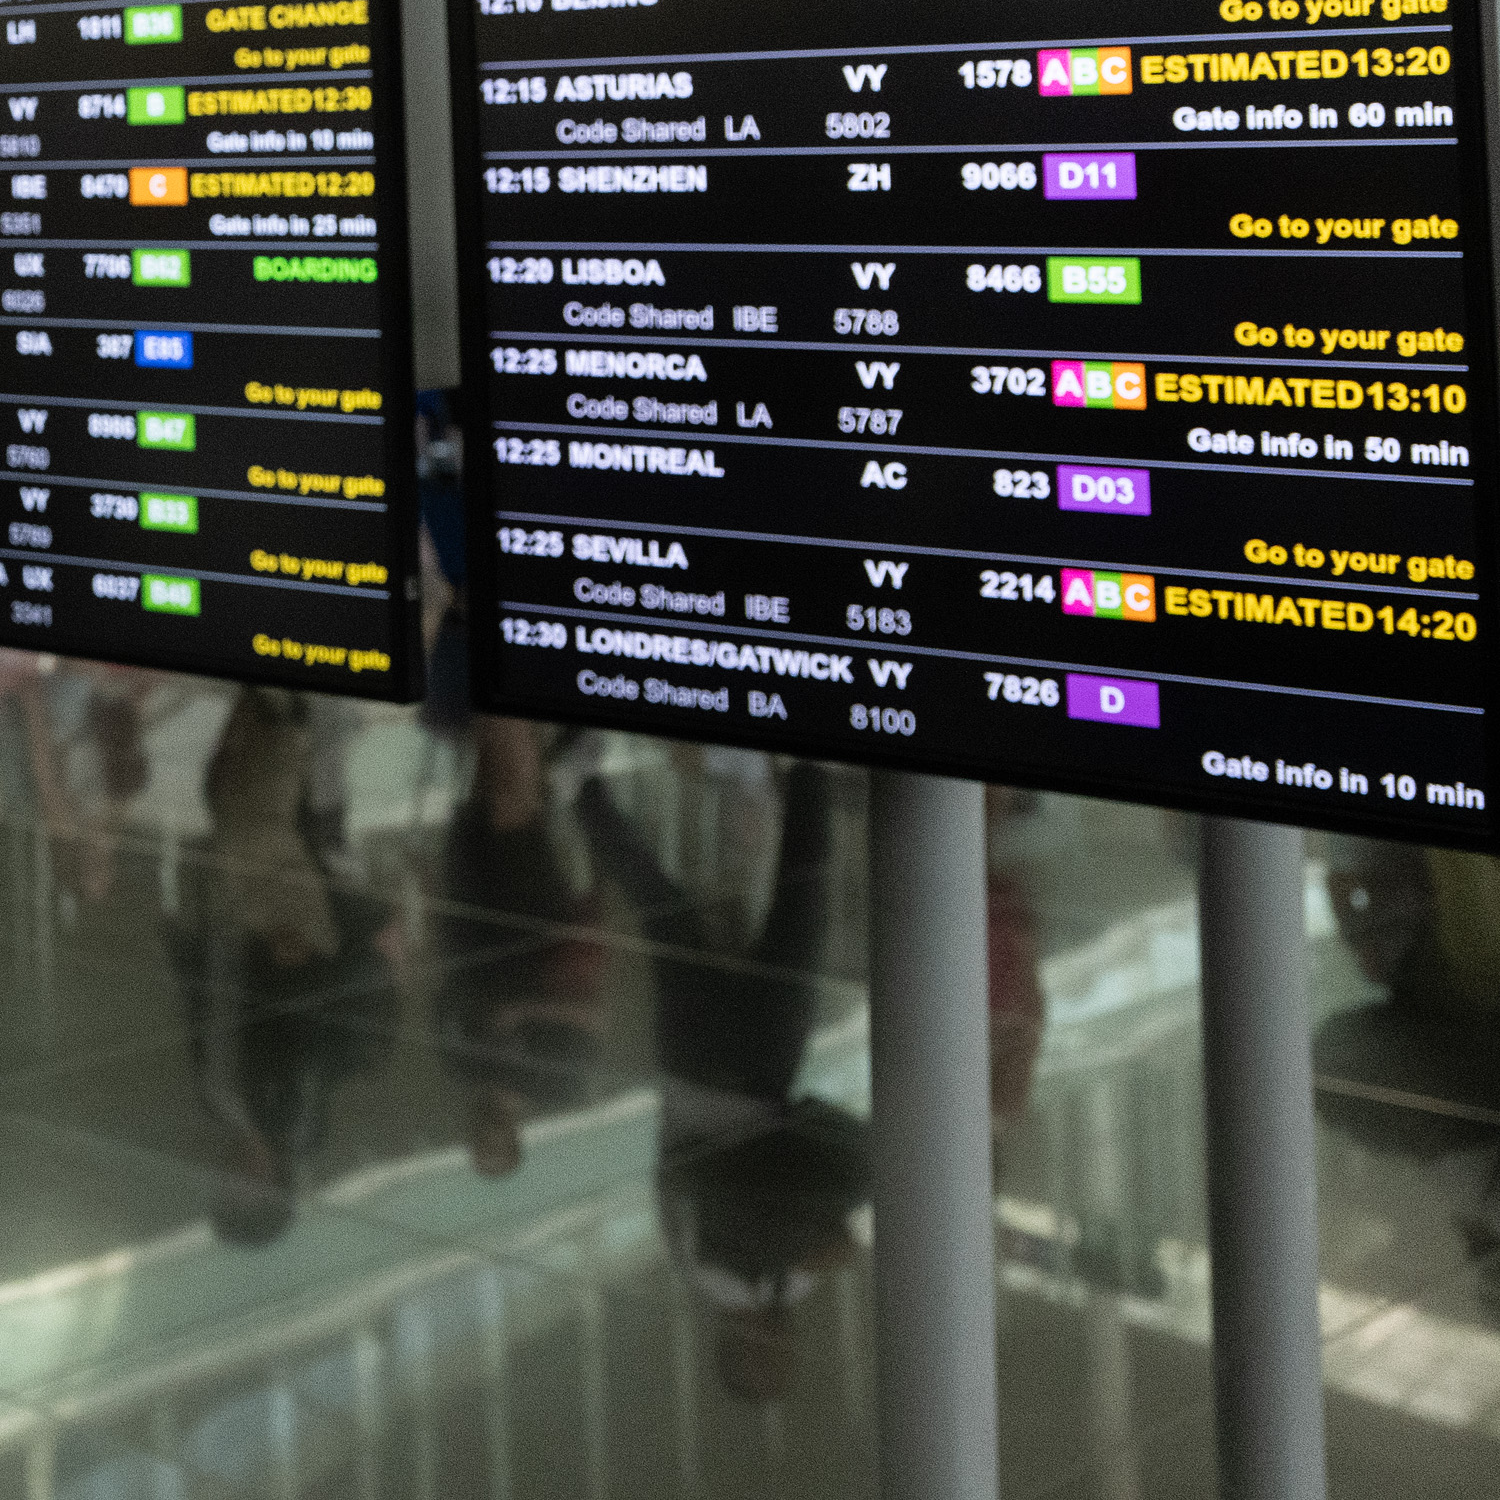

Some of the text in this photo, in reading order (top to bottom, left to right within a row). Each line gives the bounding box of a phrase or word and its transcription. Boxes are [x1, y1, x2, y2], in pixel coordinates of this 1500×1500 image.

[204, 4, 266, 33] GATE
[186, 87, 314, 116] ESTIMATED
[205, 130, 250, 153] Gate
[335, 127, 374, 150] min
[483, 160, 1117, 193] 12:15 SHENZHEN ZH 9066 D11
[494, 436, 1136, 505] 12:25 MONTREAL AC 823 D03
